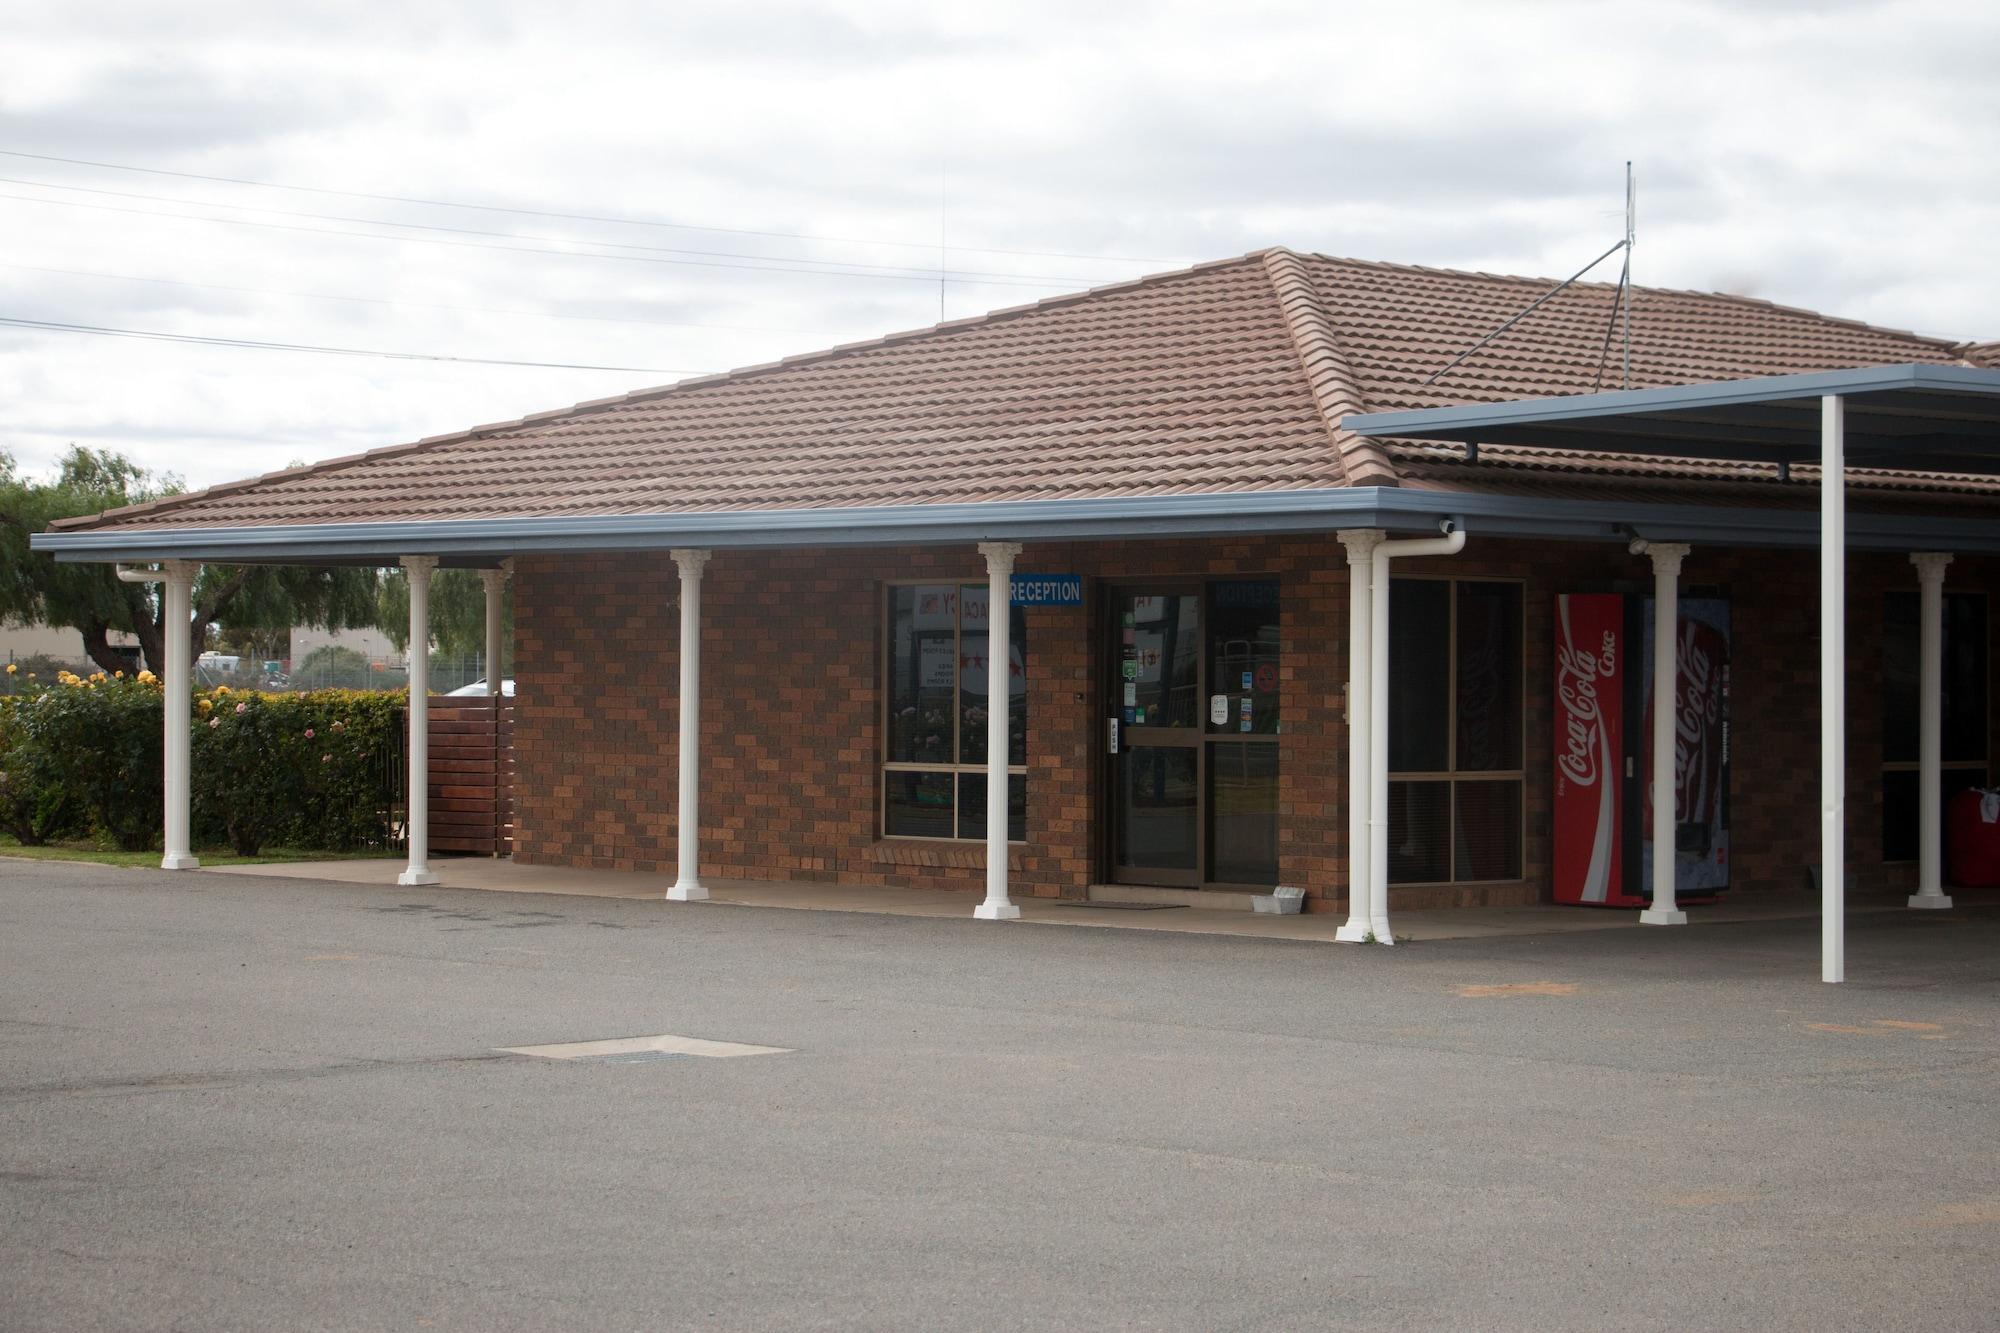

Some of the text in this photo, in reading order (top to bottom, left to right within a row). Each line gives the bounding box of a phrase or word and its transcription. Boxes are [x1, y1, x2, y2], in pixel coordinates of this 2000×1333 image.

[1009, 581, 1080, 601] RECEPTION
[1598, 630, 1615, 677] Coke
[1558, 645, 1597, 786] Coca-Cola
